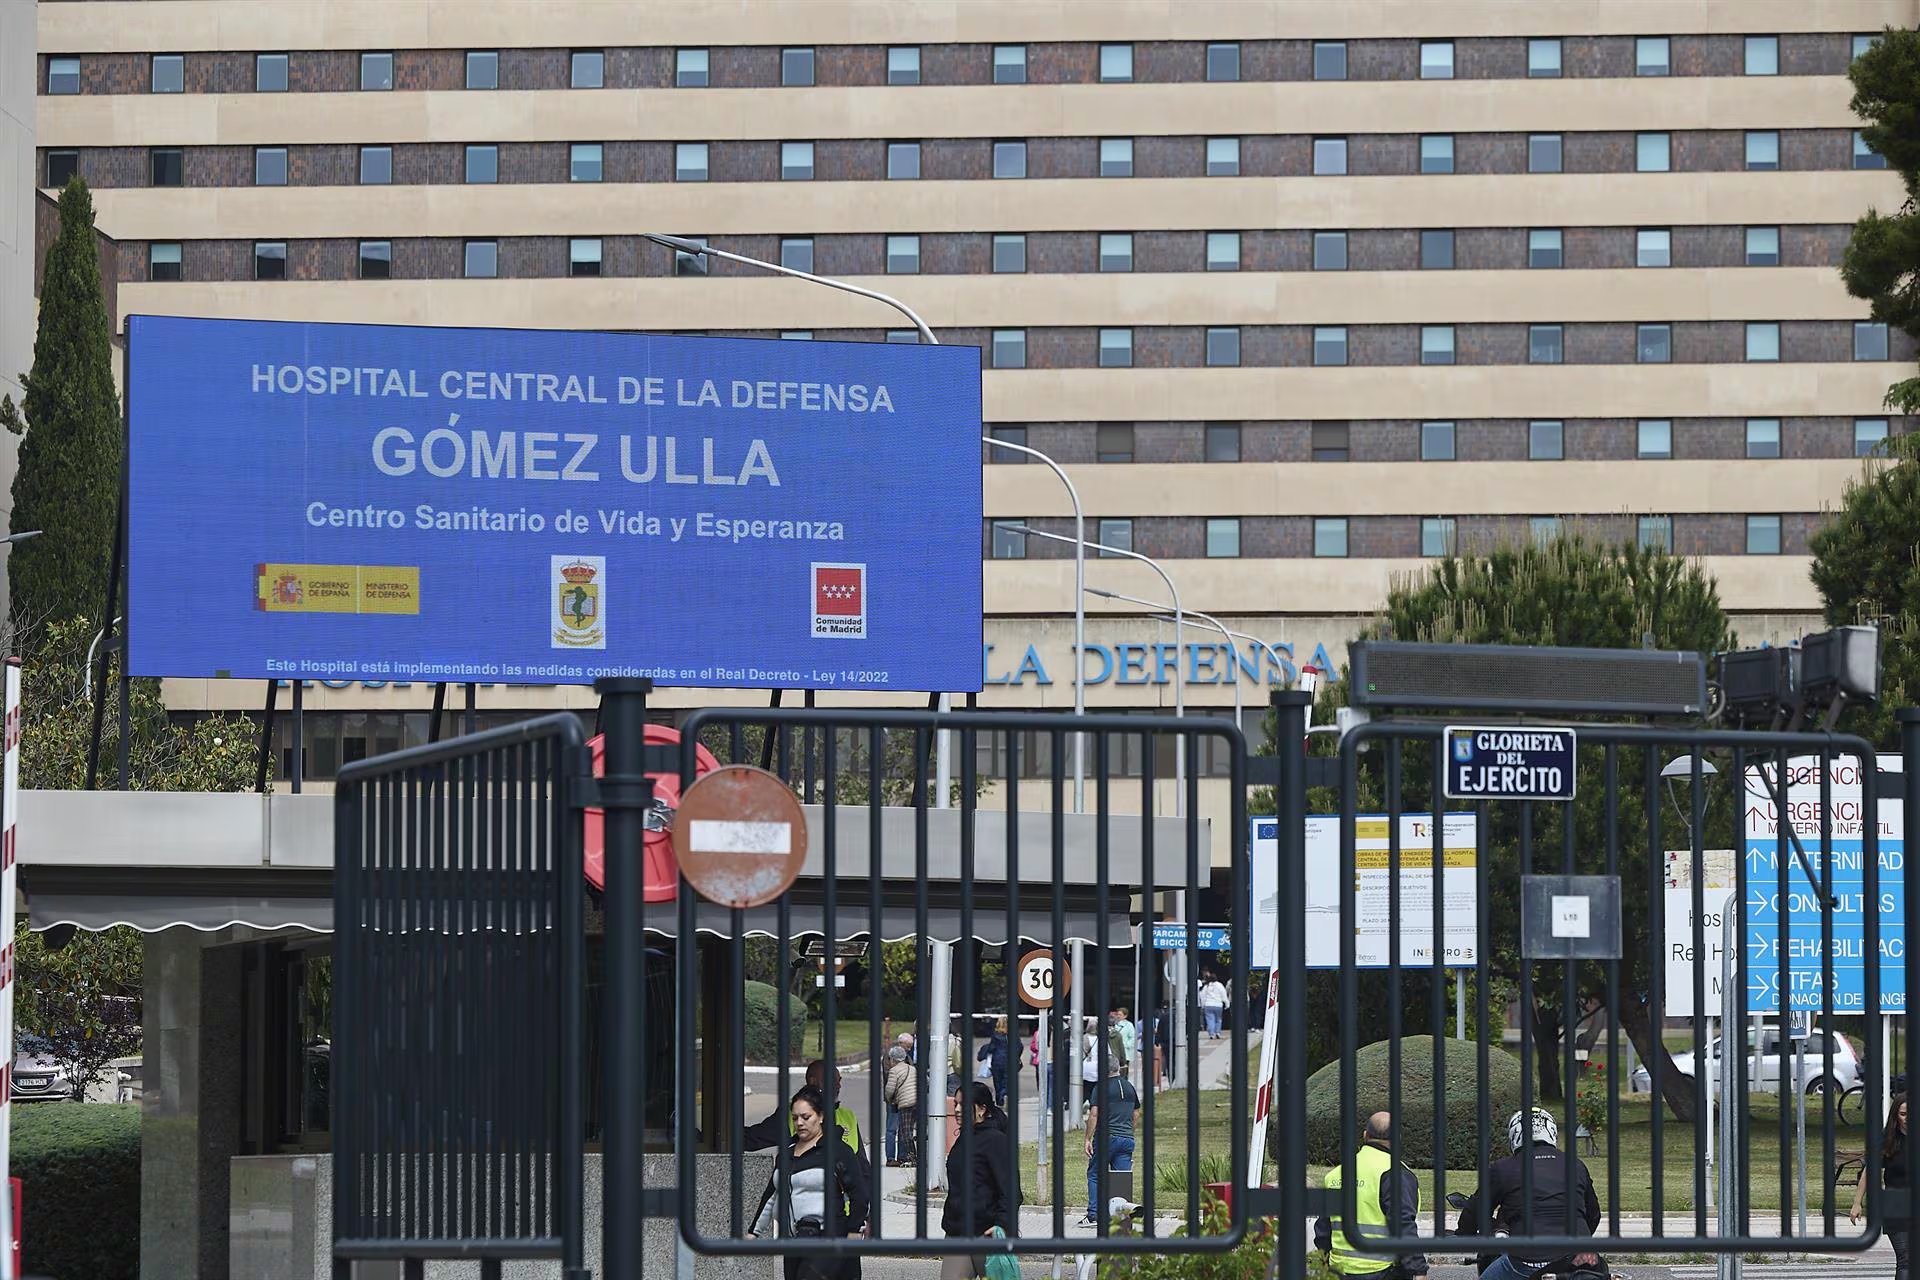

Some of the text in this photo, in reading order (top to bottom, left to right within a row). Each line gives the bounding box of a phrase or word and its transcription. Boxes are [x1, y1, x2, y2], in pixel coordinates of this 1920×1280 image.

[251, 363, 895, 414] HOSPITAL CENTRAL DE LA DEFENSA
[372, 412, 781, 488] GÓMEZ ULLA
[306, 501, 844, 543] Centro Sanitario de Vida y Esperanza
[308, 581, 350, 589] GOBIERNO
[308, 589, 319, 597] DE
[366, 582, 409, 591] MINISTERIO
[366, 590, 411, 599] DE DEFENSA
[816, 617, 862, 626] Comunidad
[830, 626, 862, 634] Madrid
[983, 641, 1338, 685] LA DEFENSA
[266, 659, 297, 671] Este
[301, 660, 357, 675] Hospital
[361, 660, 390, 673] está
[394, 662, 499, 677] implementando
[503, 664, 521, 675] las
[526, 665, 583, 677] medidas
[587, 666, 676, 679] consideradas
[680, 669, 697, 679] en
[700, 668, 711, 680] el
[716, 668, 745, 680] Real
[750, 669, 800, 681] Decreto
[813, 670, 836, 684] Ley
[841, 671, 889, 683] 14/2022
[1477, 732, 1564, 751] GLORIETA
[1497, 752, 1525, 765] DEL
[1460, 765, 1561, 793] EJERCITO
[1767, 766, 1885, 785] URGENCI
[1837, 822, 1893, 834] INFATIL
[1770, 851, 1904, 870] MATERNIAD
[1771, 893, 1895, 913] CONULTS
[1160, 939, 1211, 947] BICICLAS
[1412, 948, 1461, 957] INERO
[1029, 968, 1054, 989] 30
[1772, 993, 1862, 1005] DNACIN DE
